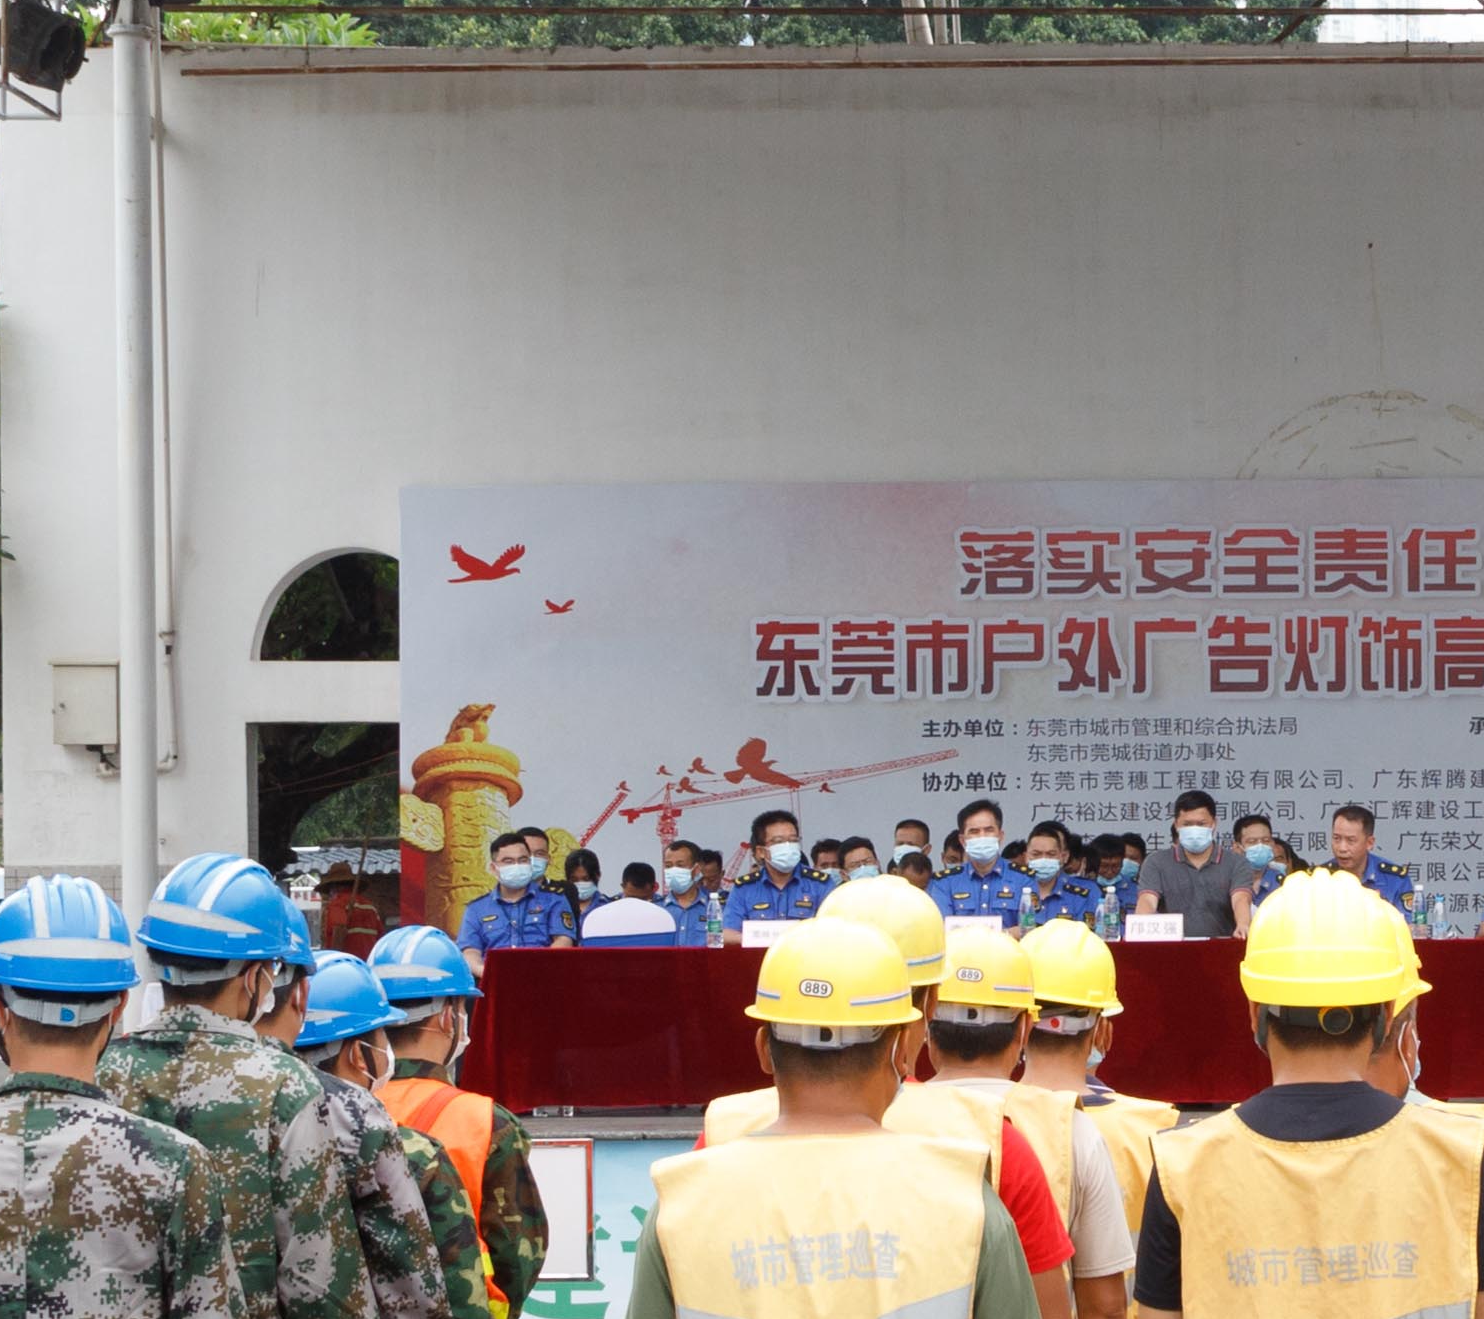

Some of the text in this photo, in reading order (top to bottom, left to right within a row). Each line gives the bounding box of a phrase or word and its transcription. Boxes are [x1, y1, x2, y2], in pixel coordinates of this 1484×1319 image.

[960, 528, 1481, 595] 落实安全责任
[1027, 743, 1235, 763] 东莞市莞城街道办事处
[803, 982, 829, 995] 889
[959, 969, 981, 980] 889
[731, 1230, 900, 1289] 城市管理巡查
[1226, 1241, 1420, 1287] 城市管理巡查
